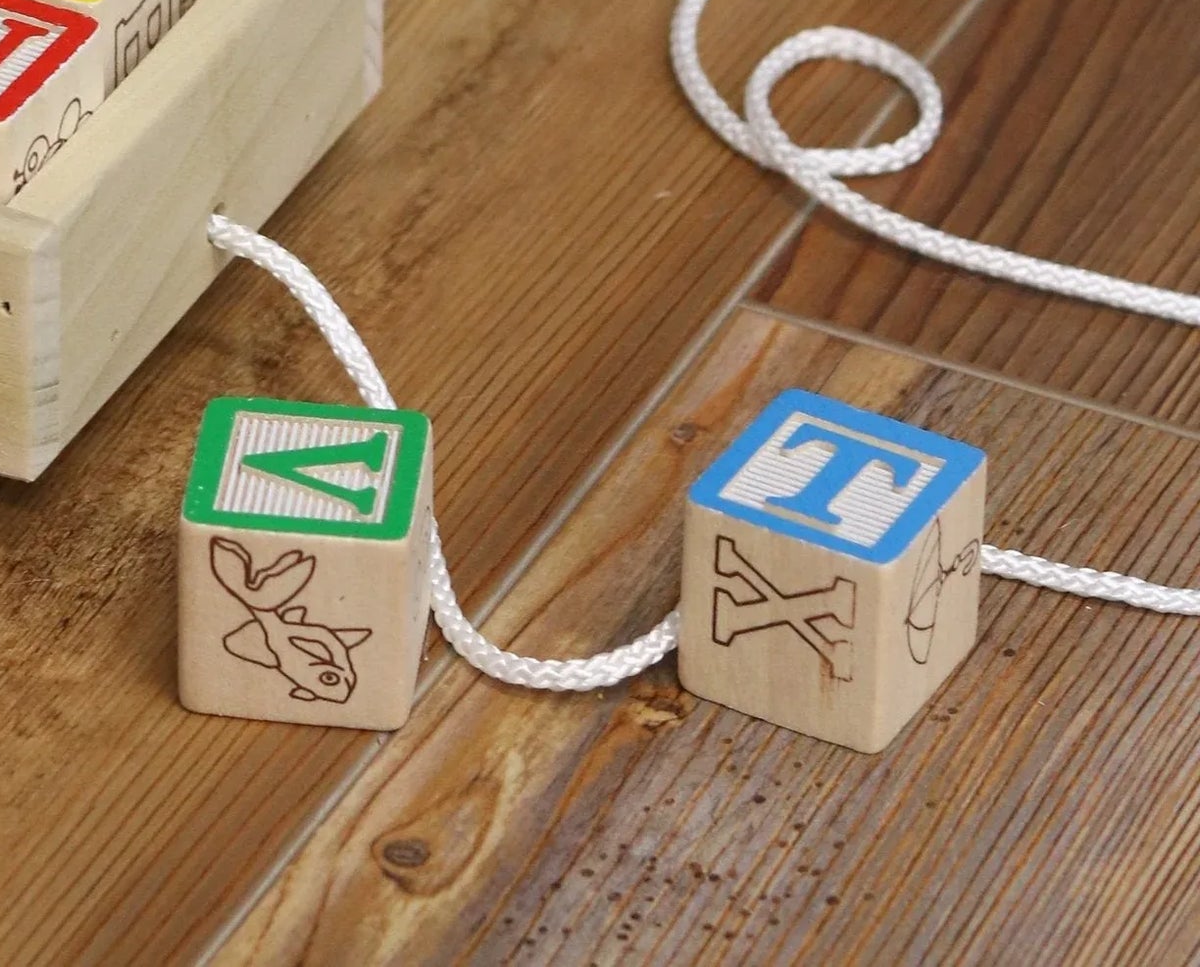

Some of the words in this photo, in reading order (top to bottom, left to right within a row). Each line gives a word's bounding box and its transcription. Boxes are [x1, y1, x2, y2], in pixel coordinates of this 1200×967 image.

[241, 431, 390, 516] V
[764, 422, 922, 526] T
[712, 534, 858, 683] X
